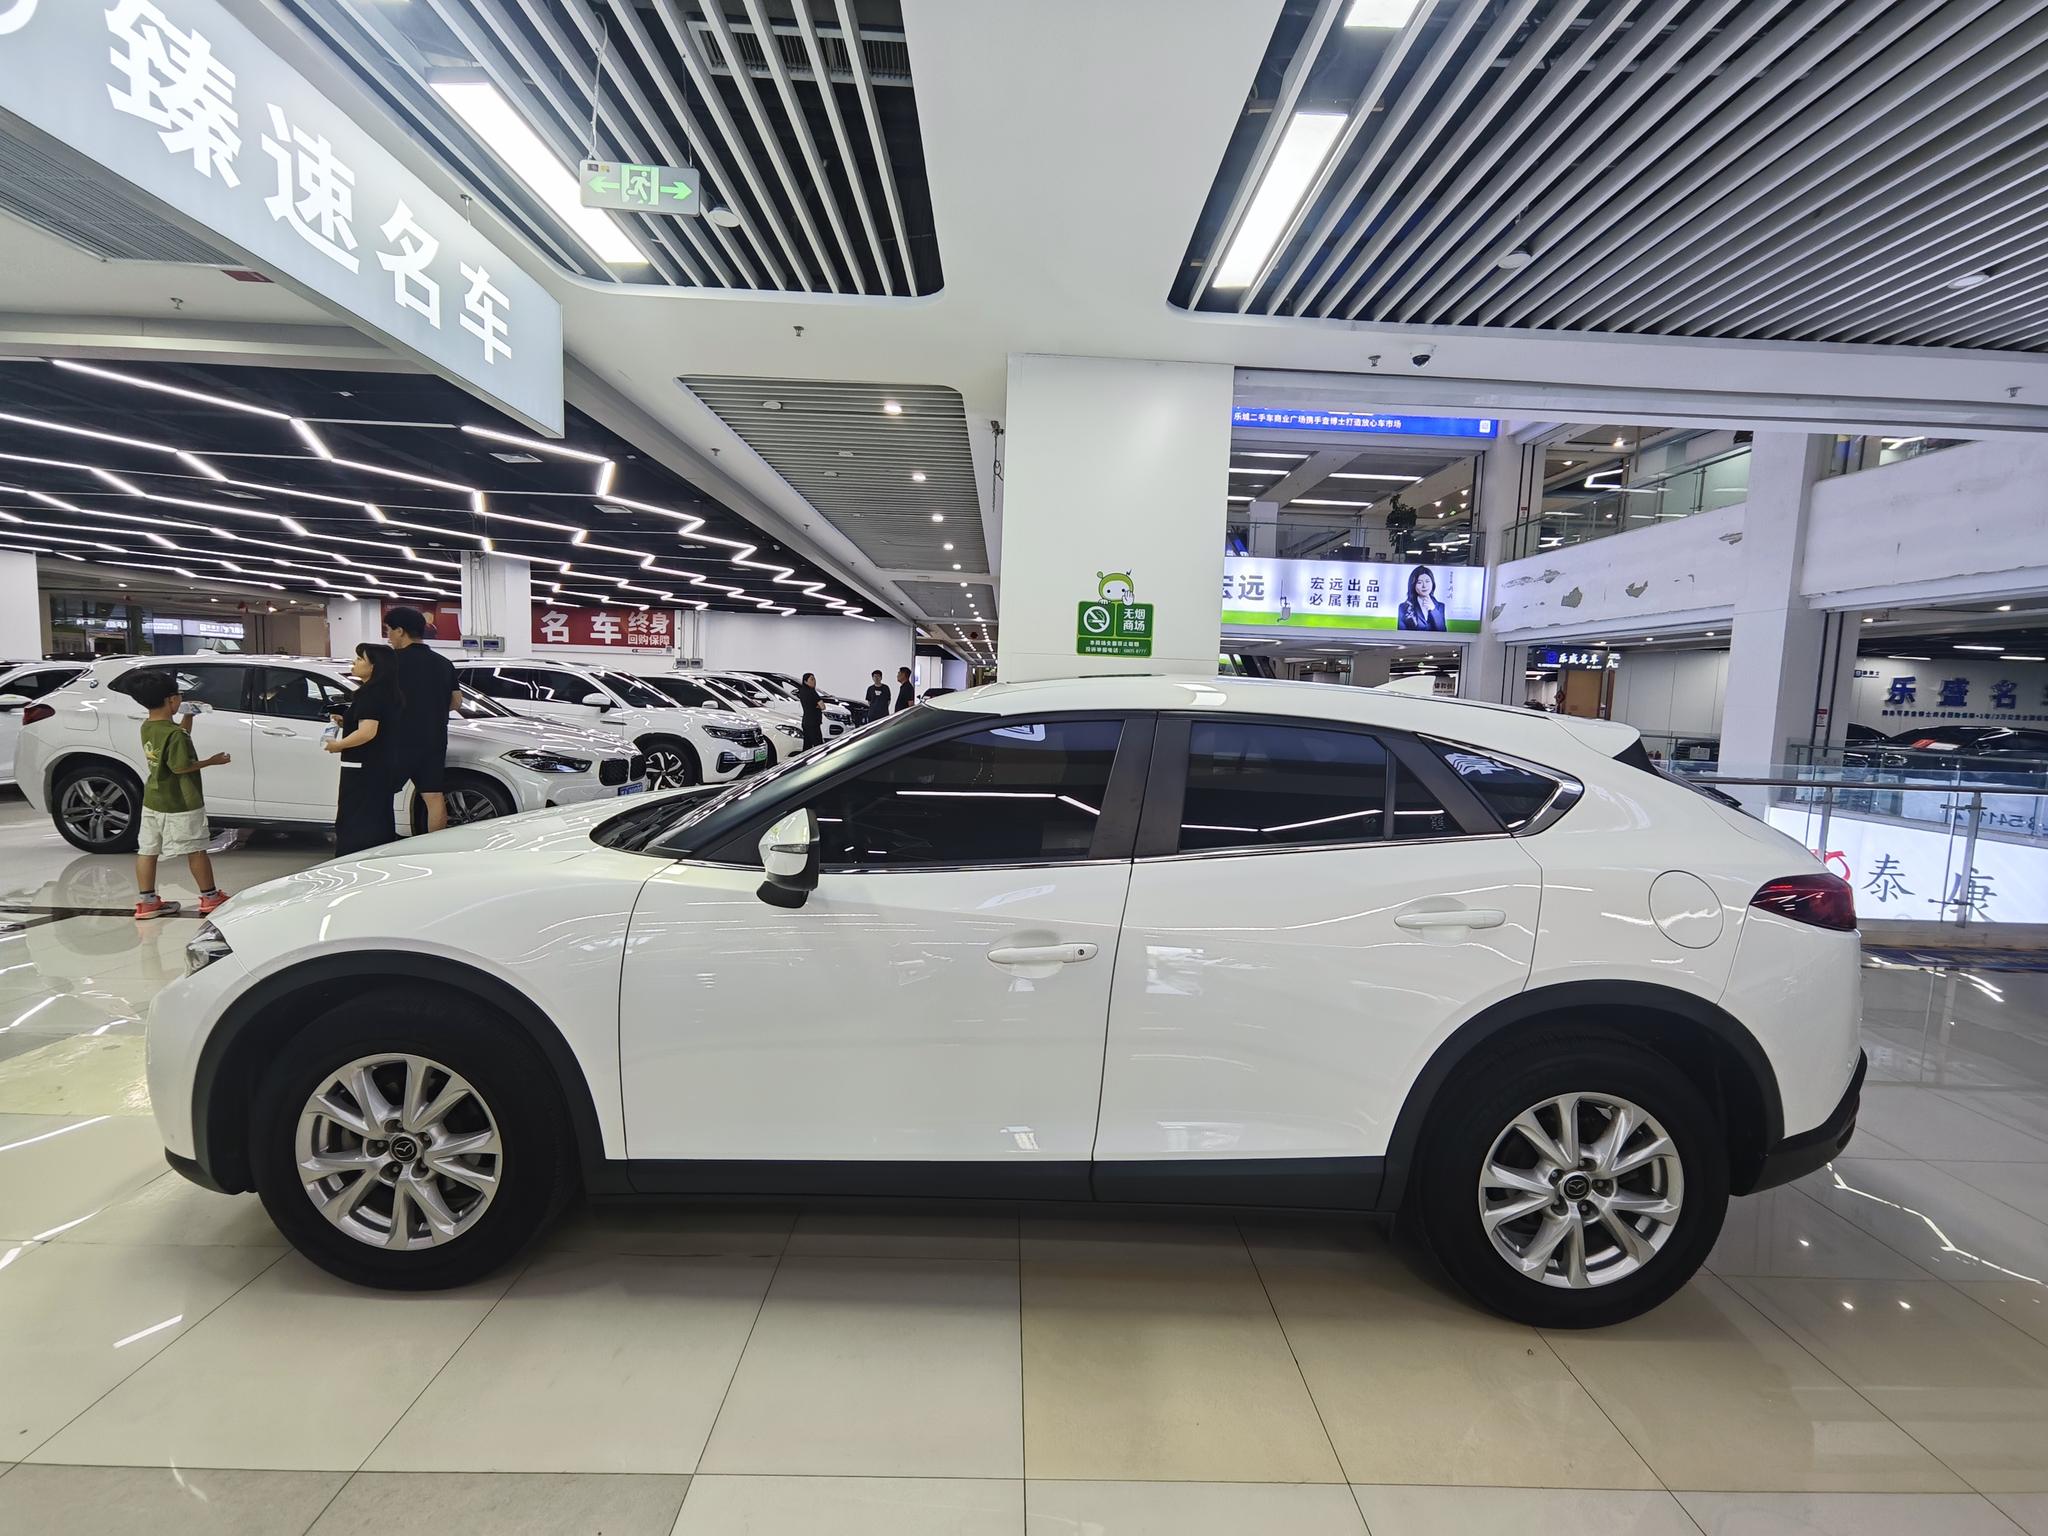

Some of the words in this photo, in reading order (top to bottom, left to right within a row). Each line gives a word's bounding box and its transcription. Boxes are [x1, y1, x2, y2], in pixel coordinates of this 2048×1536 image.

[103, 0, 513, 366] 臻速名车
[1310, 576, 1380, 593] 宏远出品
[1309, 592, 1379, 609] 必属精品
[1123, 608, 1146, 620] 无烟
[628, 611, 670, 635] 终身
[1123, 620, 1145, 631] 商场
[628, 634, 670, 647] 回购保障
[1862, 853, 1998, 923] 泰康
